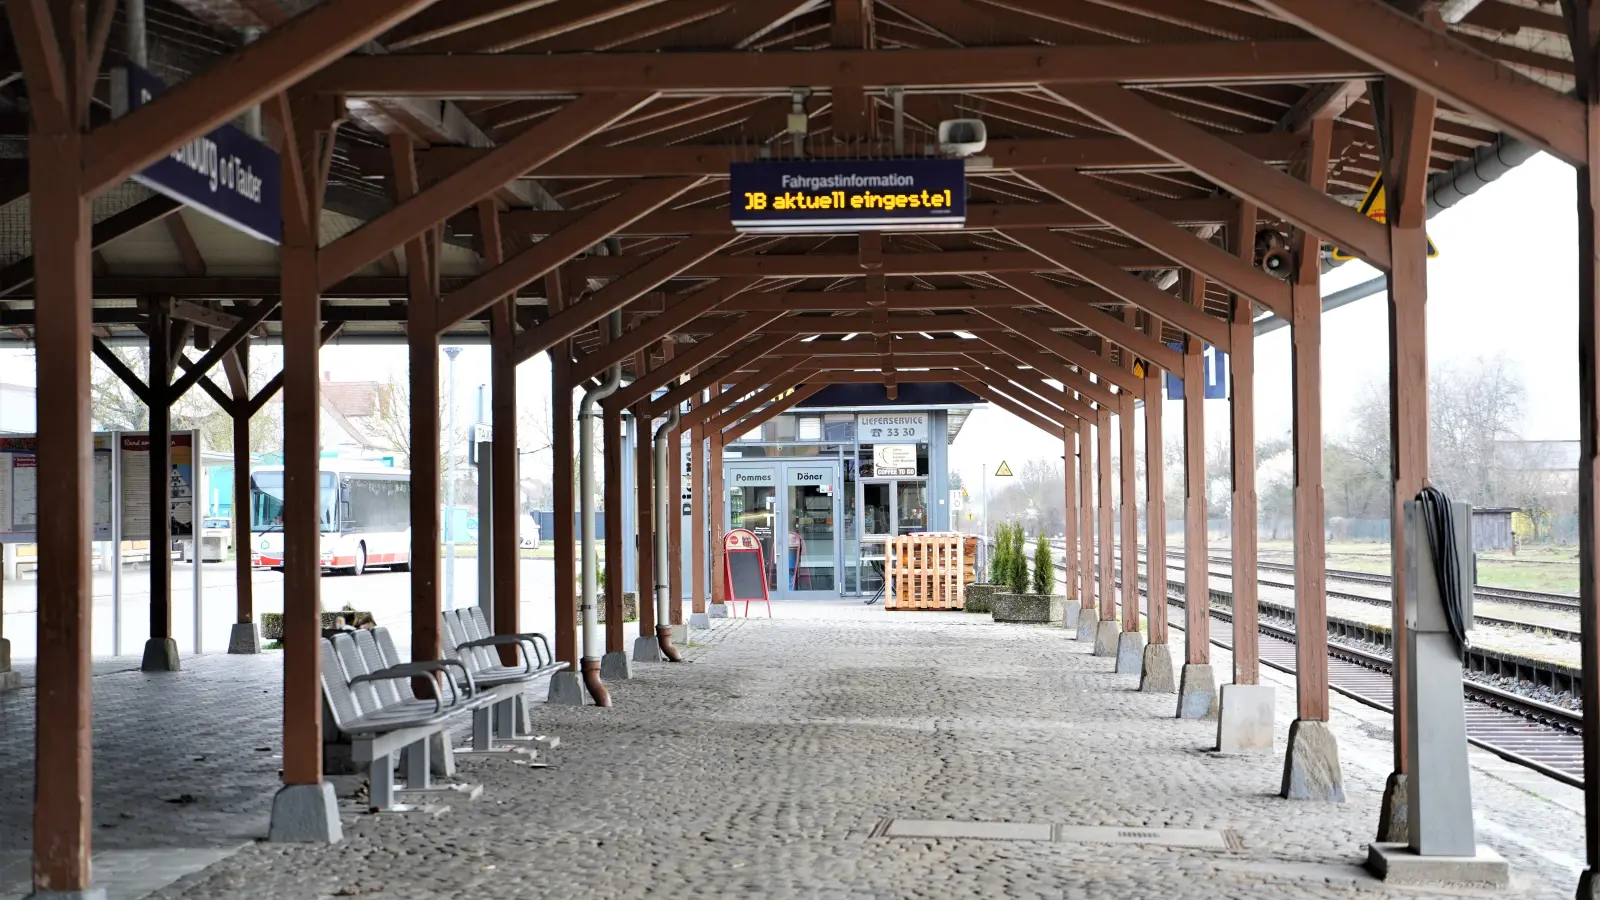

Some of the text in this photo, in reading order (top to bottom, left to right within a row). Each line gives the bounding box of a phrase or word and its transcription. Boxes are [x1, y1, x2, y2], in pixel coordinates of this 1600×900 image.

[234, 156, 262, 204] Tauber
[781, 173, 914, 191] Fahrgastinformation
[773, 191, 845, 210] aktuell
[850, 189, 952, 211] eingestel
[1203, 345, 1217, 386] 1
[861, 416, 923, 426] LIEFERSERVICE
[478, 427, 491, 440] TAX
[887, 427, 916, 437] 33 30
[735, 472, 772, 482] Pommes
[796, 471, 823, 482] Döner
